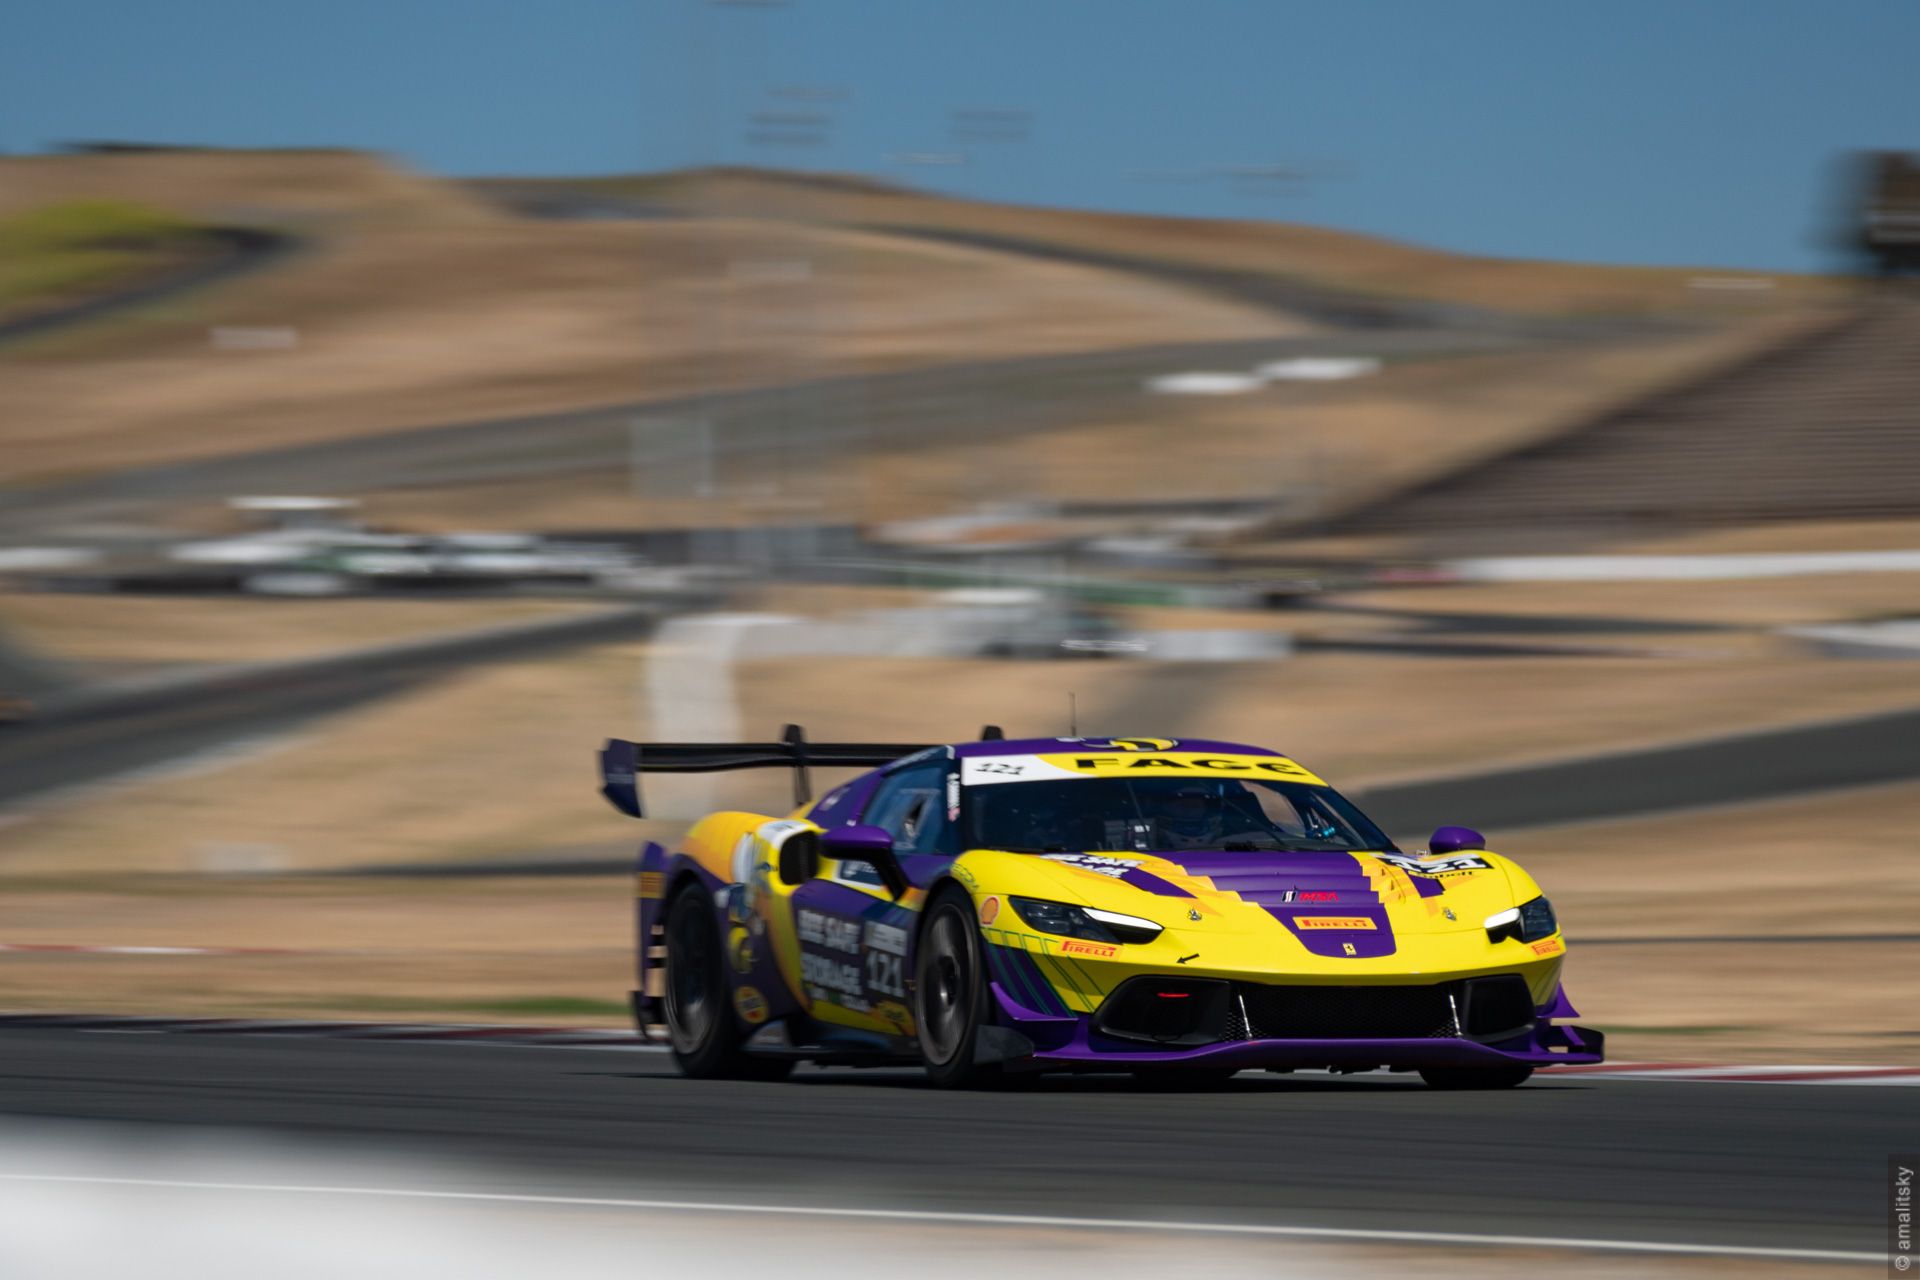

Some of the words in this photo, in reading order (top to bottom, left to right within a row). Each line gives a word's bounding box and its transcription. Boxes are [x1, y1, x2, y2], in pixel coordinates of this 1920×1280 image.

[974, 762, 1024, 775] 121
[1390, 858, 1487, 873] 121
[1299, 890, 1339, 902] IMSA
[1302, 919, 1368, 928] PIRELLI
[1062, 940, 1116, 957] PIRELLI
[865, 949, 906, 998] 121
